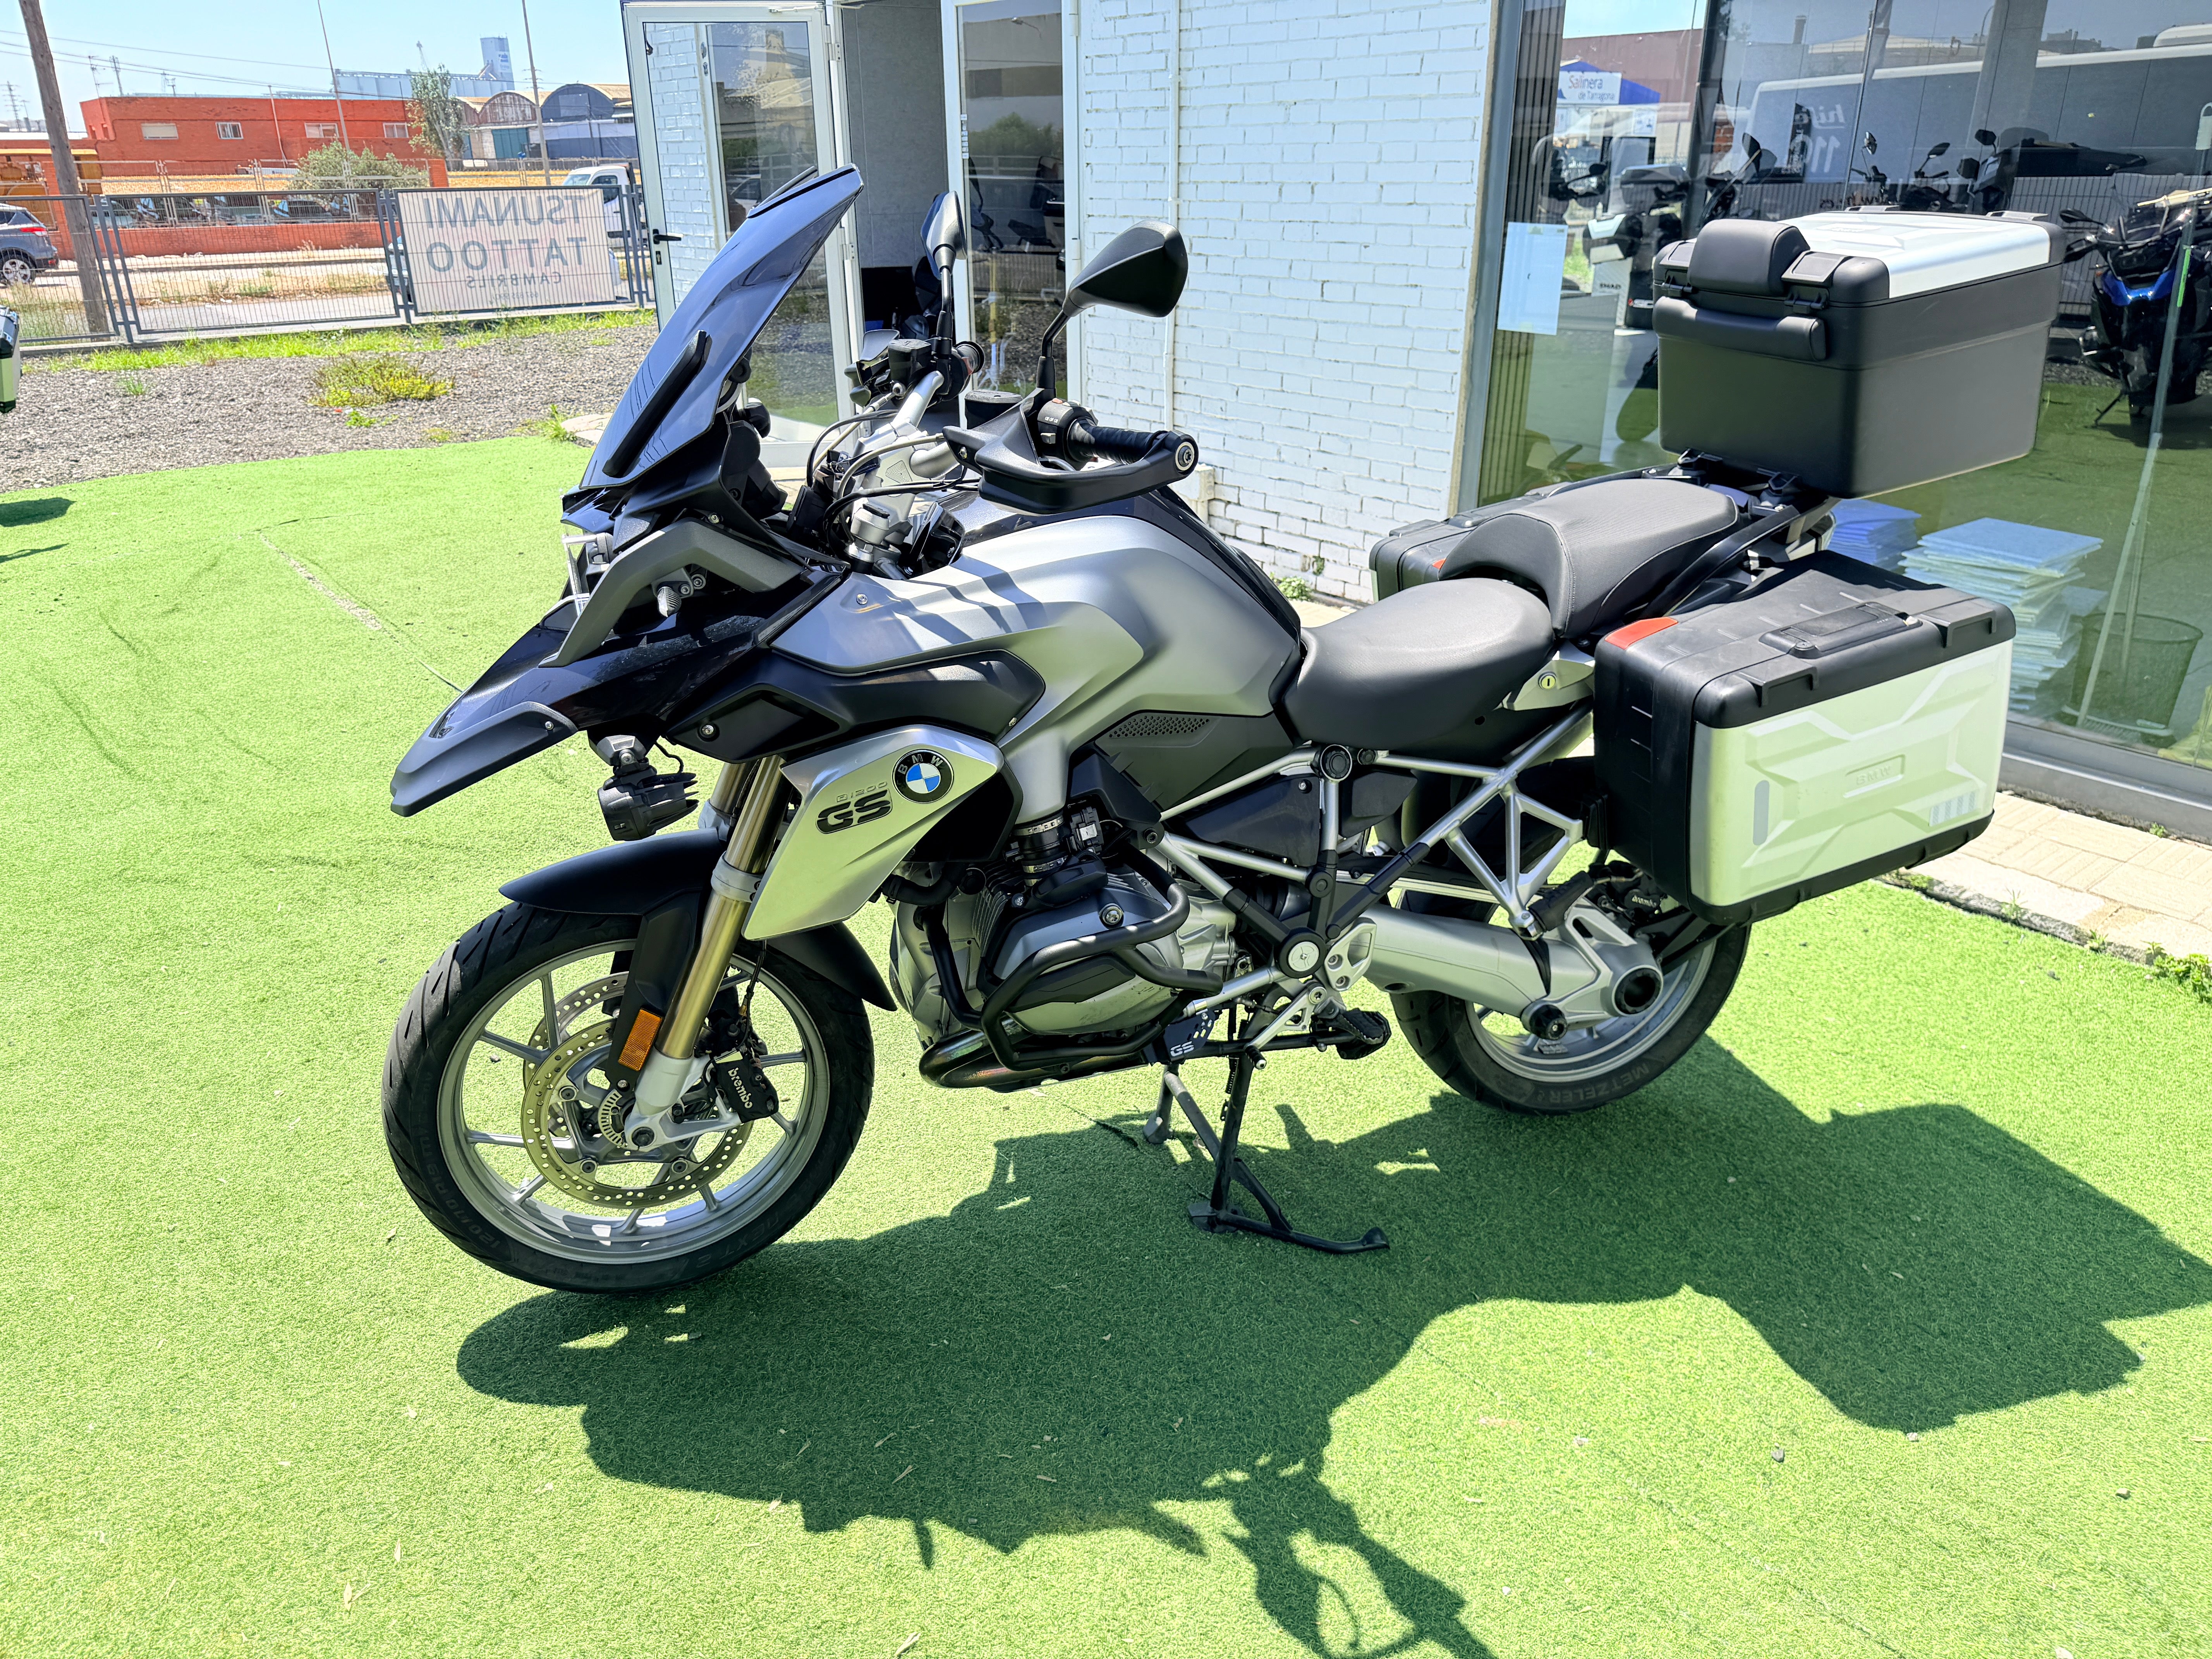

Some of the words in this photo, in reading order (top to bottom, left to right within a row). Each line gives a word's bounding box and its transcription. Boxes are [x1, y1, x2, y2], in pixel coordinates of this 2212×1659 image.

[1568, 75, 1603, 89] Salinera
[897, 753, 943, 775] BMW
[1856, 766, 1891, 785] BMW
[816, 789, 891, 833] GS
[1170, 1041, 1194, 1057] GS
[727, 1066, 753, 1109] brembo
[1549, 1062, 1651, 1104] METZELER
